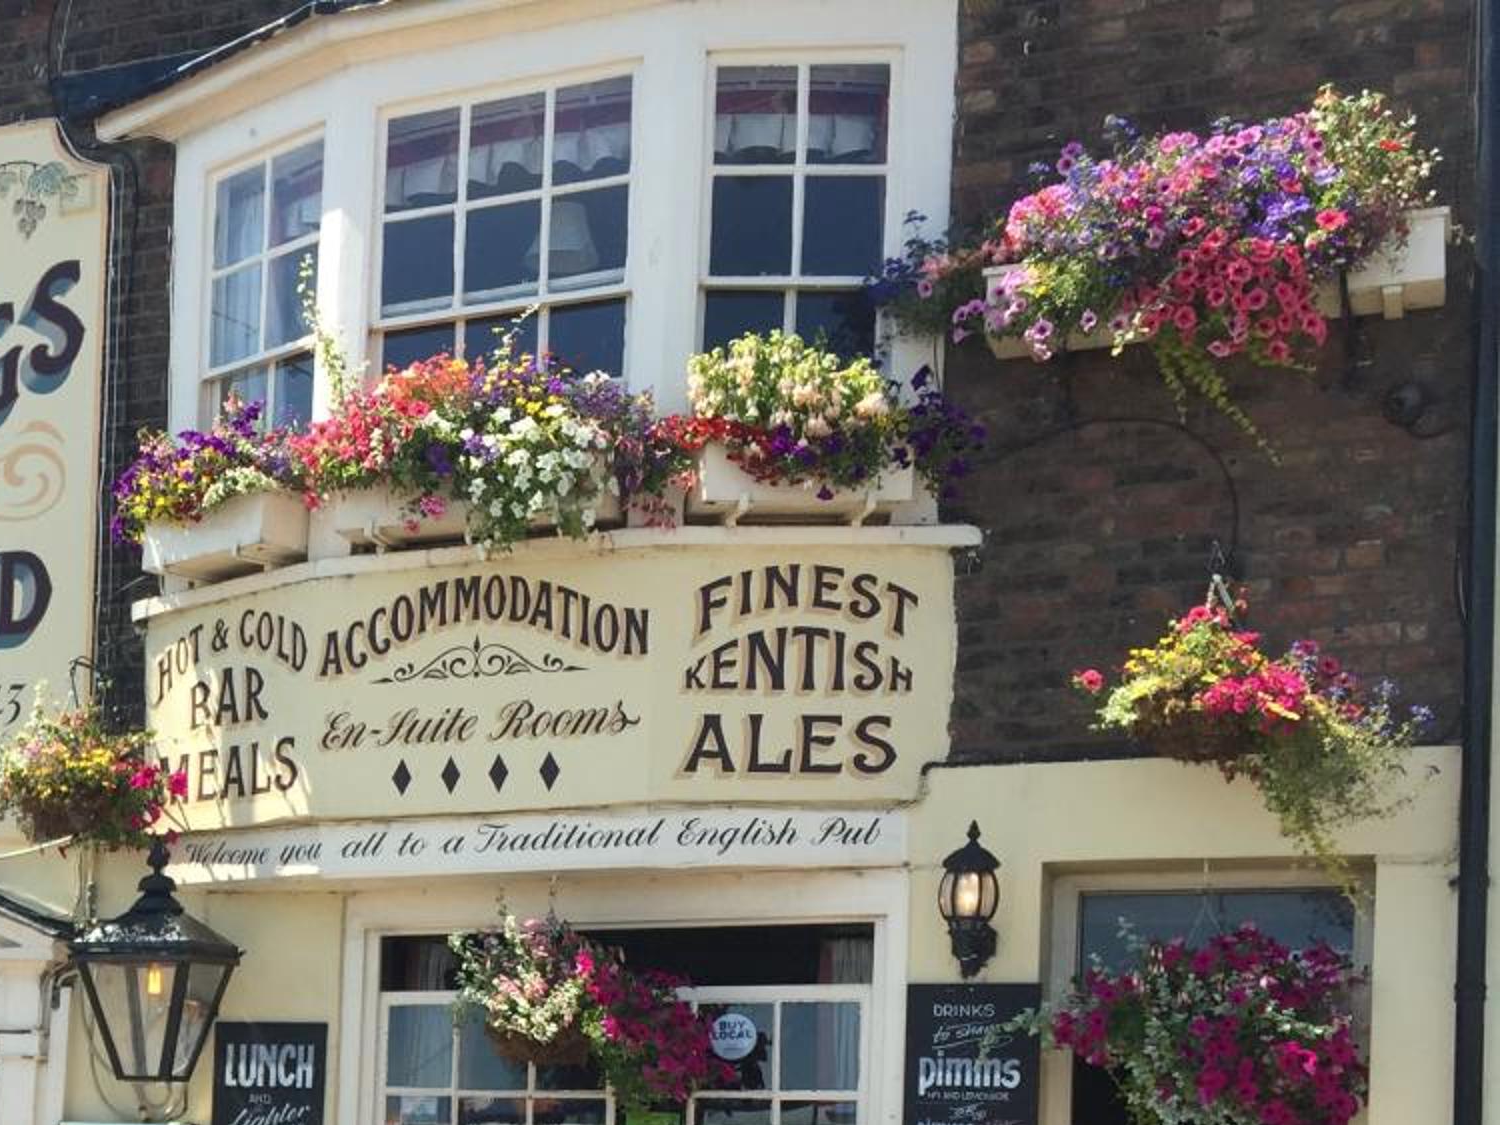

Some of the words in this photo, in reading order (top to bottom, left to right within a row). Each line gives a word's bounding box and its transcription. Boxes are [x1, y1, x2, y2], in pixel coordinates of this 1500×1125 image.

[319, 574, 650, 678] ACCOMMODATION
[695, 563, 919, 638] FINEST
[155, 623, 204, 707] HOT
[211, 618, 230, 652] &
[239, 608, 308, 673] COLD
[683, 625, 914, 692] KENTISH
[189, 666, 269, 731] BAR
[320, 706, 479, 752] En-Suite
[488, 699, 641, 742] Rooms
[157, 736, 298, 807] MEALS
[681, 713, 899, 775] ALES
[184, 843, 270, 866] Welcome
[279, 841, 323, 866] you
[341, 831, 388, 859] all
[398, 832, 427, 858] to
[442, 833, 466, 855] a
[473, 818, 666, 853] Traditional
[675, 817, 799, 856] English
[809, 816, 882, 846] Pub
[712, 1029, 754, 1041] LOCAL
[719, 1019, 746, 1031] BUY
[933, 1003, 996, 1018] DRINKS
[224, 1042, 316, 1089] LUNCH
[918, 1049, 1021, 1097] pimms
